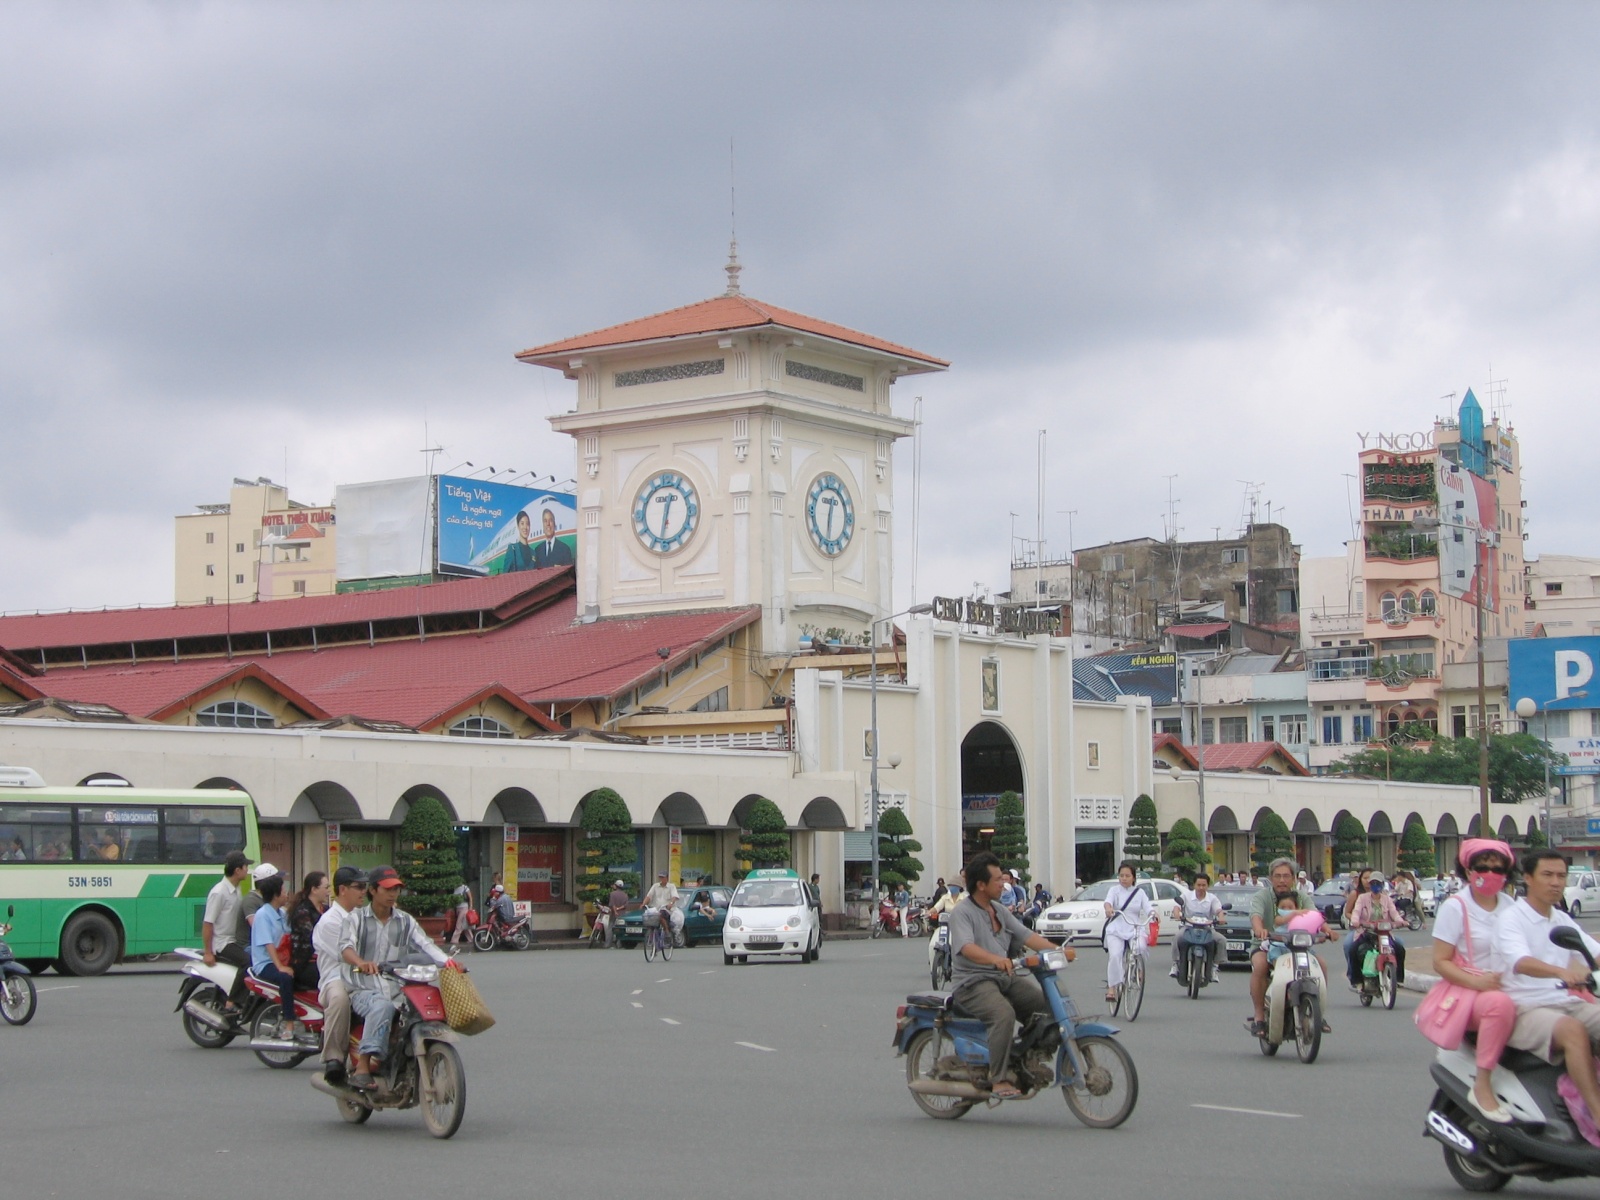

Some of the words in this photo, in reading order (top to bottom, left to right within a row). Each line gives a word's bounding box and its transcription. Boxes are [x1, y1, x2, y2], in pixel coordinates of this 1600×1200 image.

[1357, 432, 1369, 449] Y
[1440, 465, 1465, 494] Canon
[445, 484, 472, 502] Tiếng
[473, 488, 492, 503] Việt
[262, 514, 285, 527] HOTEL
[1555, 649, 1594, 700] P
[262, 842, 284, 853] PAINT
[361, 844, 383, 854] PAINT
